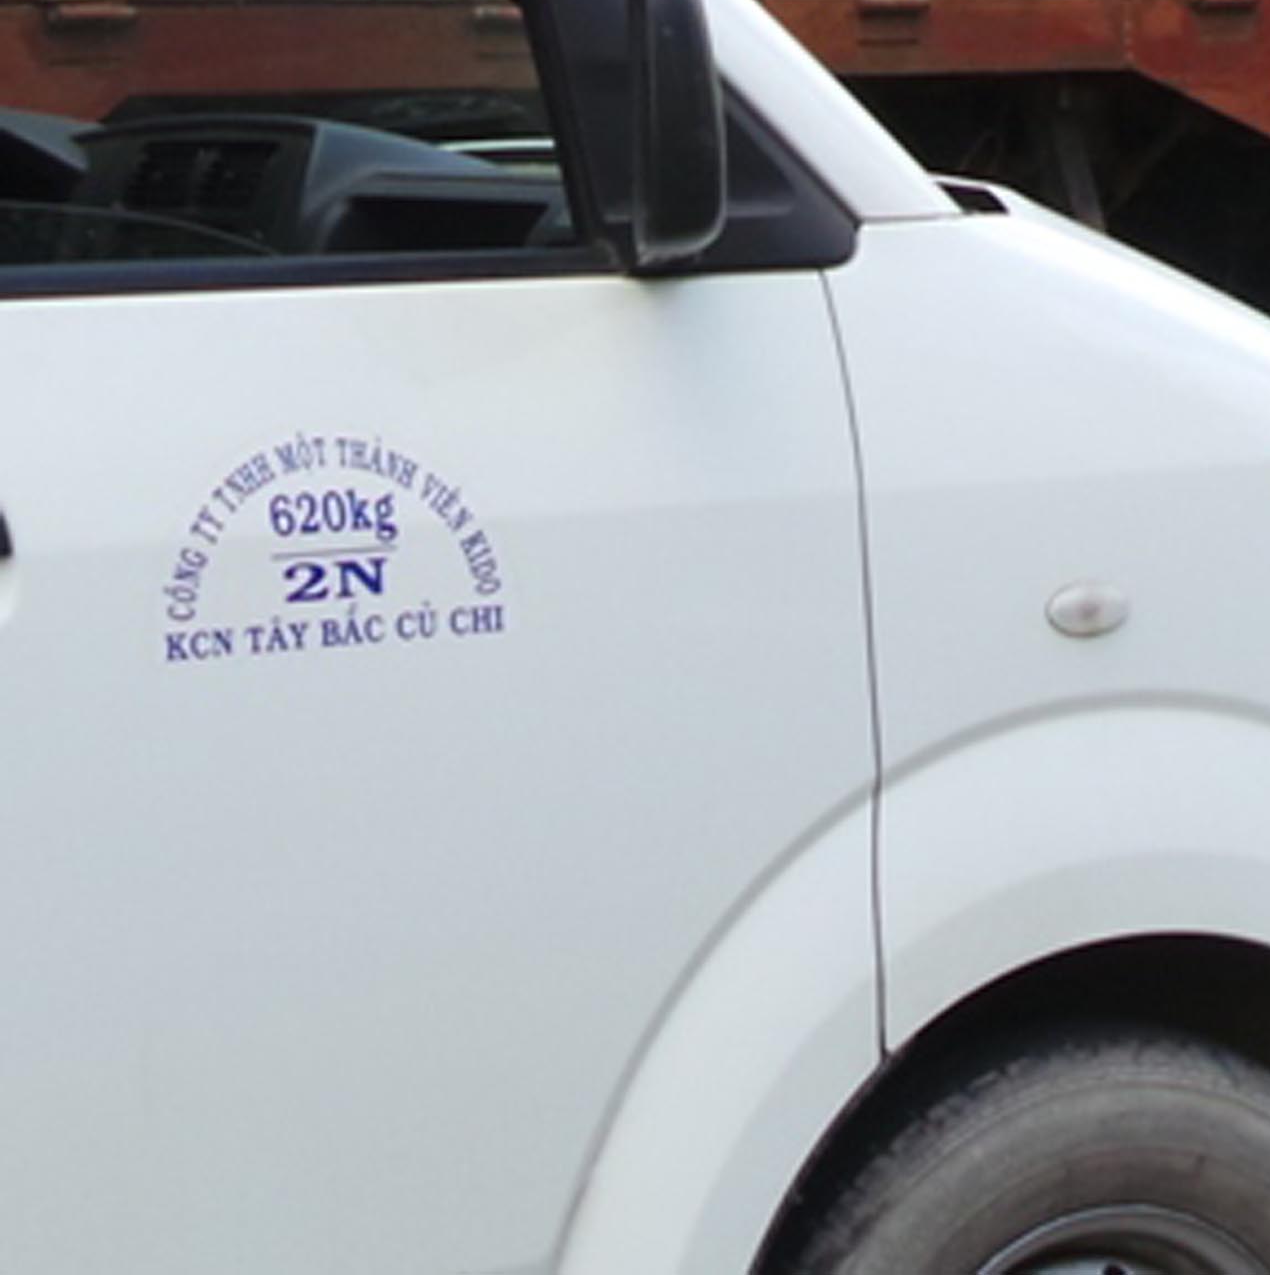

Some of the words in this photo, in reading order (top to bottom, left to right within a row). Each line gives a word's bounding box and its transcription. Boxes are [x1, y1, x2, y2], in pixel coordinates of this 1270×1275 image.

[163, 547, 209, 622] CÔNG
[190, 504, 224, 545] TY
[212, 453, 276, 513] TNHH
[420, 473, 474, 532] VIÊN
[269, 488, 398, 543] 620kg
[283, 557, 387, 603] 2N
[165, 627, 234, 661] KCN
[245, 616, 309, 655] TÂY
[320, 603, 386, 647] BẮC
[395, 601, 438, 641] CỦ
[449, 605, 506, 636] CHI
